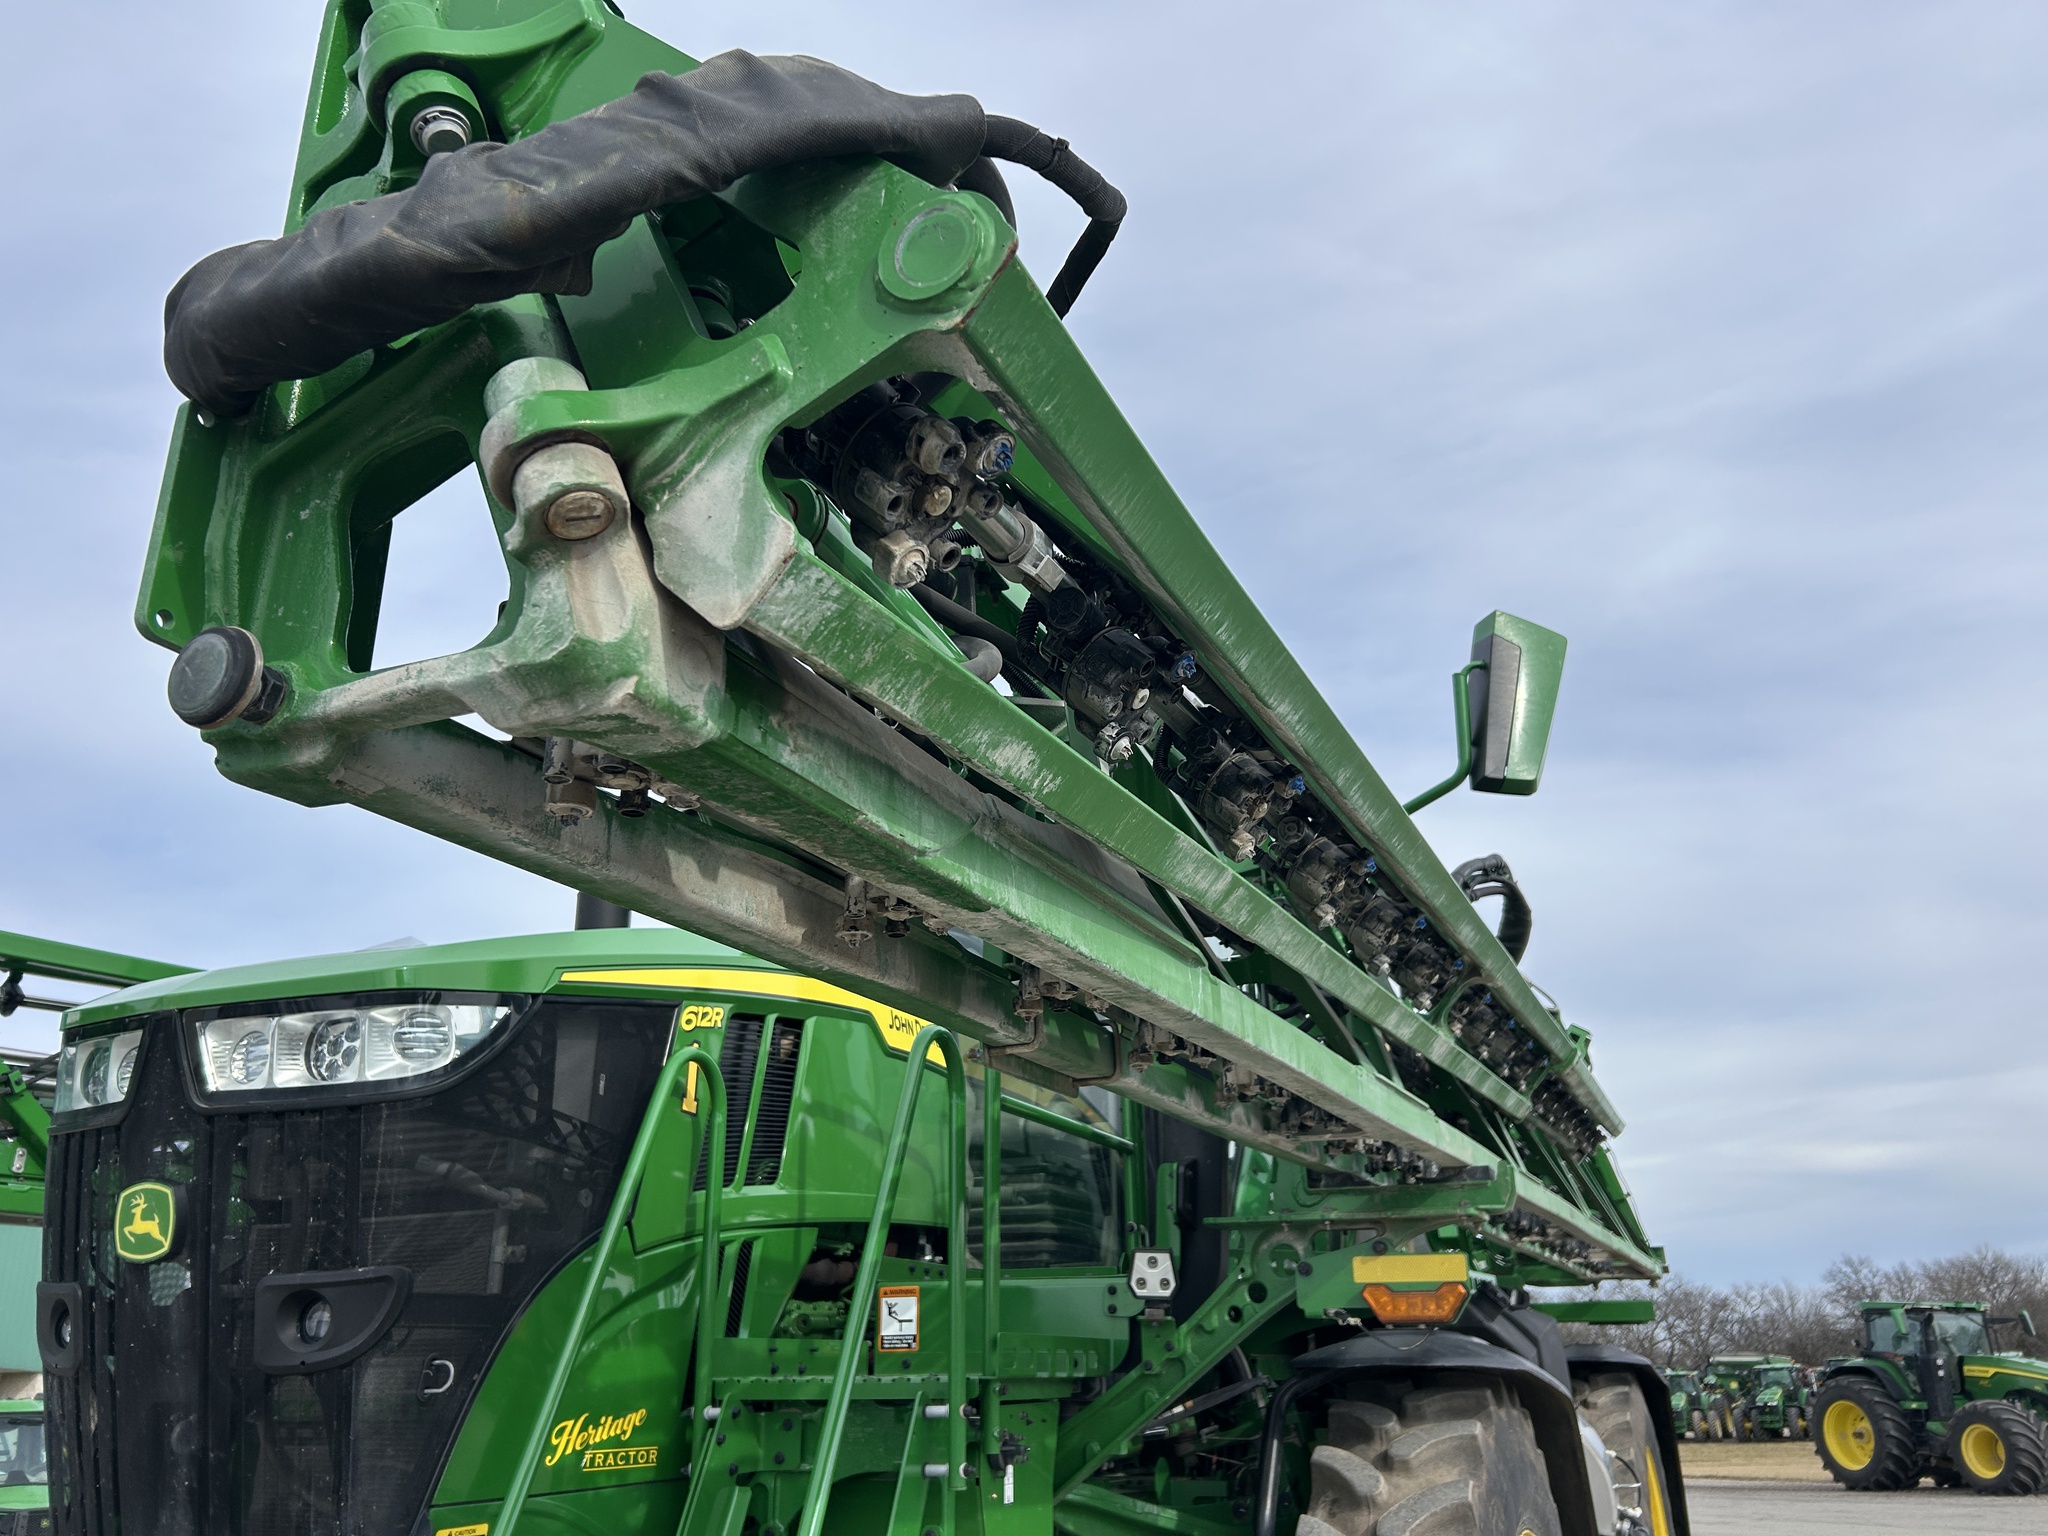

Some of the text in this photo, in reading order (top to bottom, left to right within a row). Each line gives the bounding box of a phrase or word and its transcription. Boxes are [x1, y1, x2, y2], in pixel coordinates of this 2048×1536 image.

[680, 1005, 724, 1032] 612R
[888, 1009, 915, 1037] JOHN
[545, 1408, 648, 1467] Heritage
[584, 1449, 658, 1468] TRACTOR
